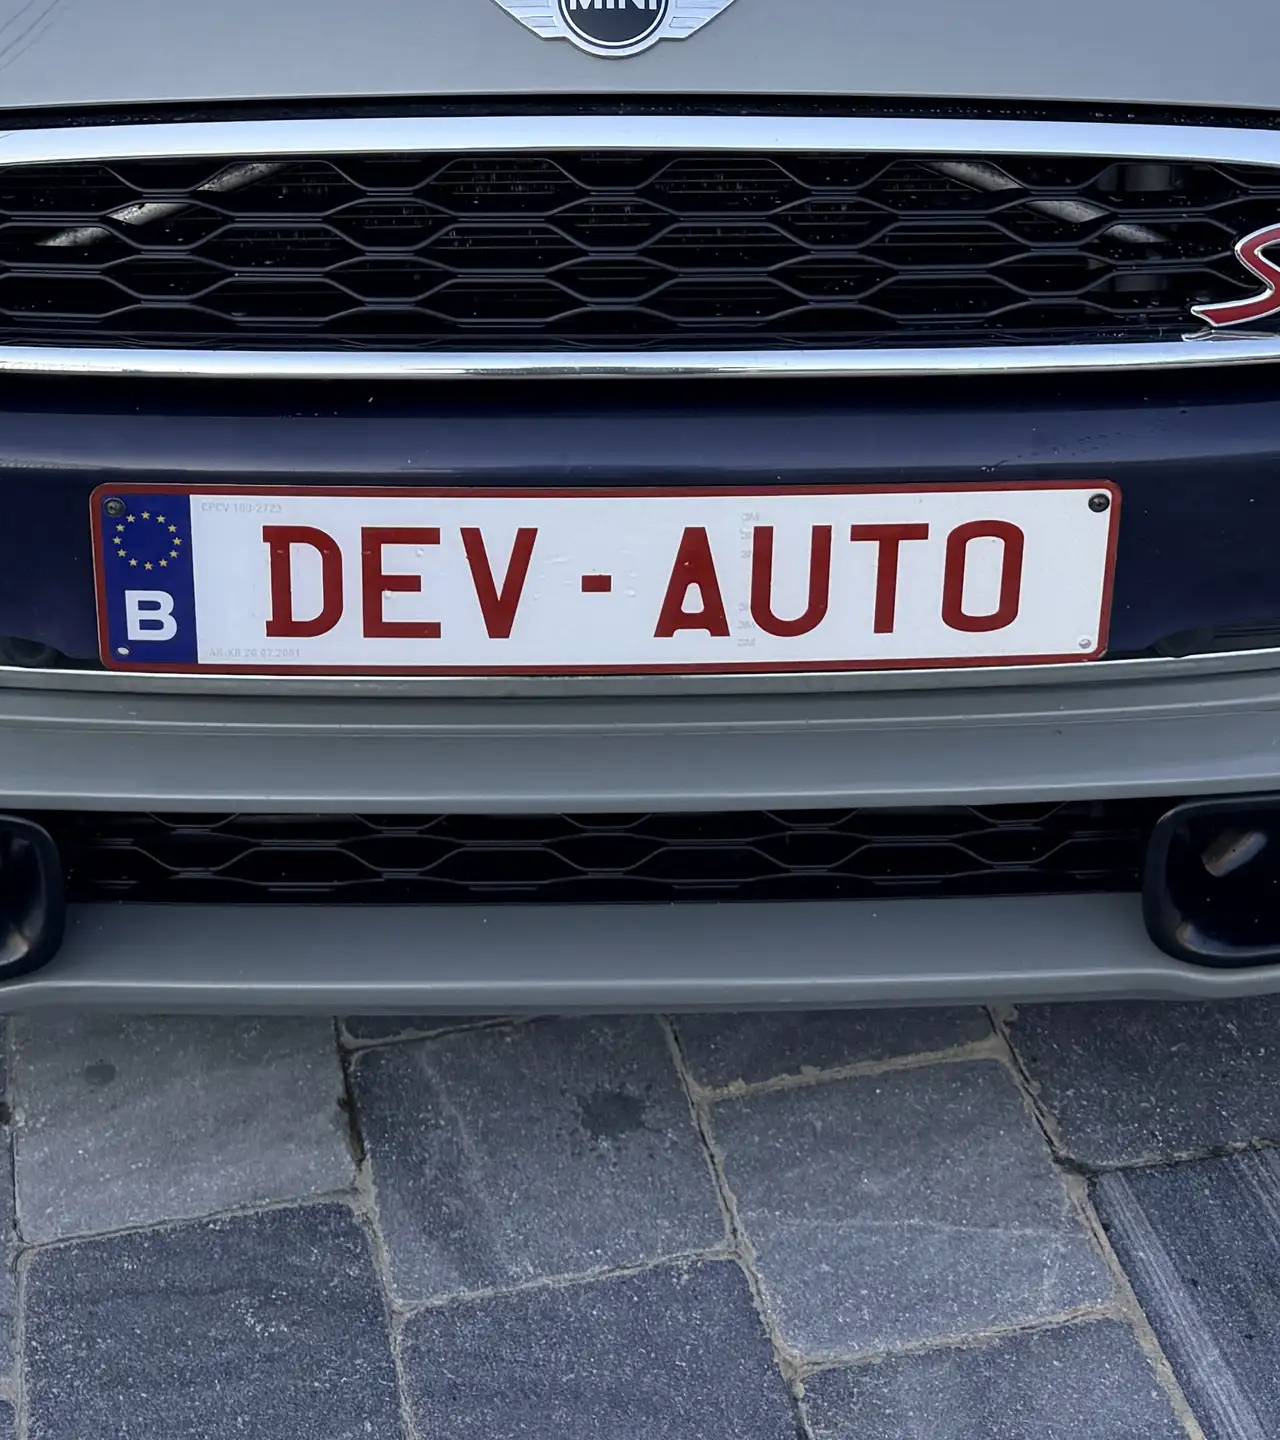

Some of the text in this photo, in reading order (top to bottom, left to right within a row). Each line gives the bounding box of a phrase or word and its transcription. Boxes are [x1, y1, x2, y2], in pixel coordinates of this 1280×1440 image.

[124, 589, 178, 642] B
[262, 525, 538, 639] DEV
[654, 520, 1025, 638] AUTO
